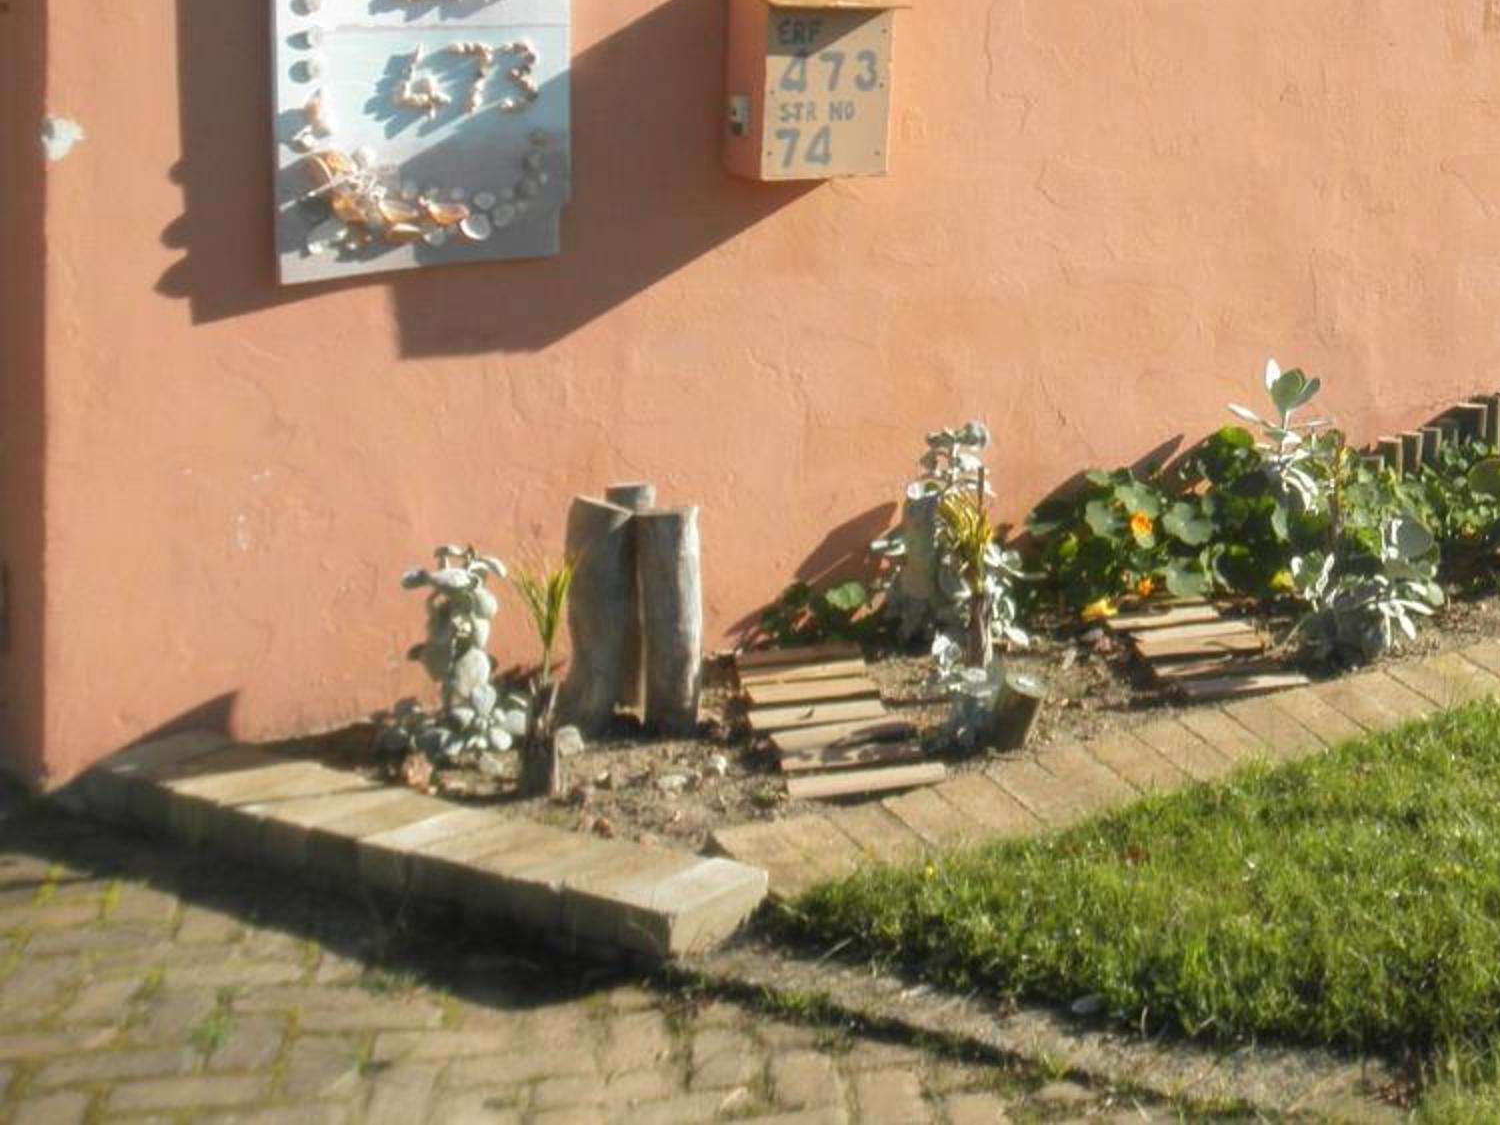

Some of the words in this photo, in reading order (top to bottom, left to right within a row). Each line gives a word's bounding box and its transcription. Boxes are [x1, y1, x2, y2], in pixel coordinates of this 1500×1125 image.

[776, 19, 821, 45] ERF
[396, 41, 541, 121] 473
[779, 49, 878, 93] 473
[778, 101, 817, 123] STR
[775, 126, 832, 169] 74
